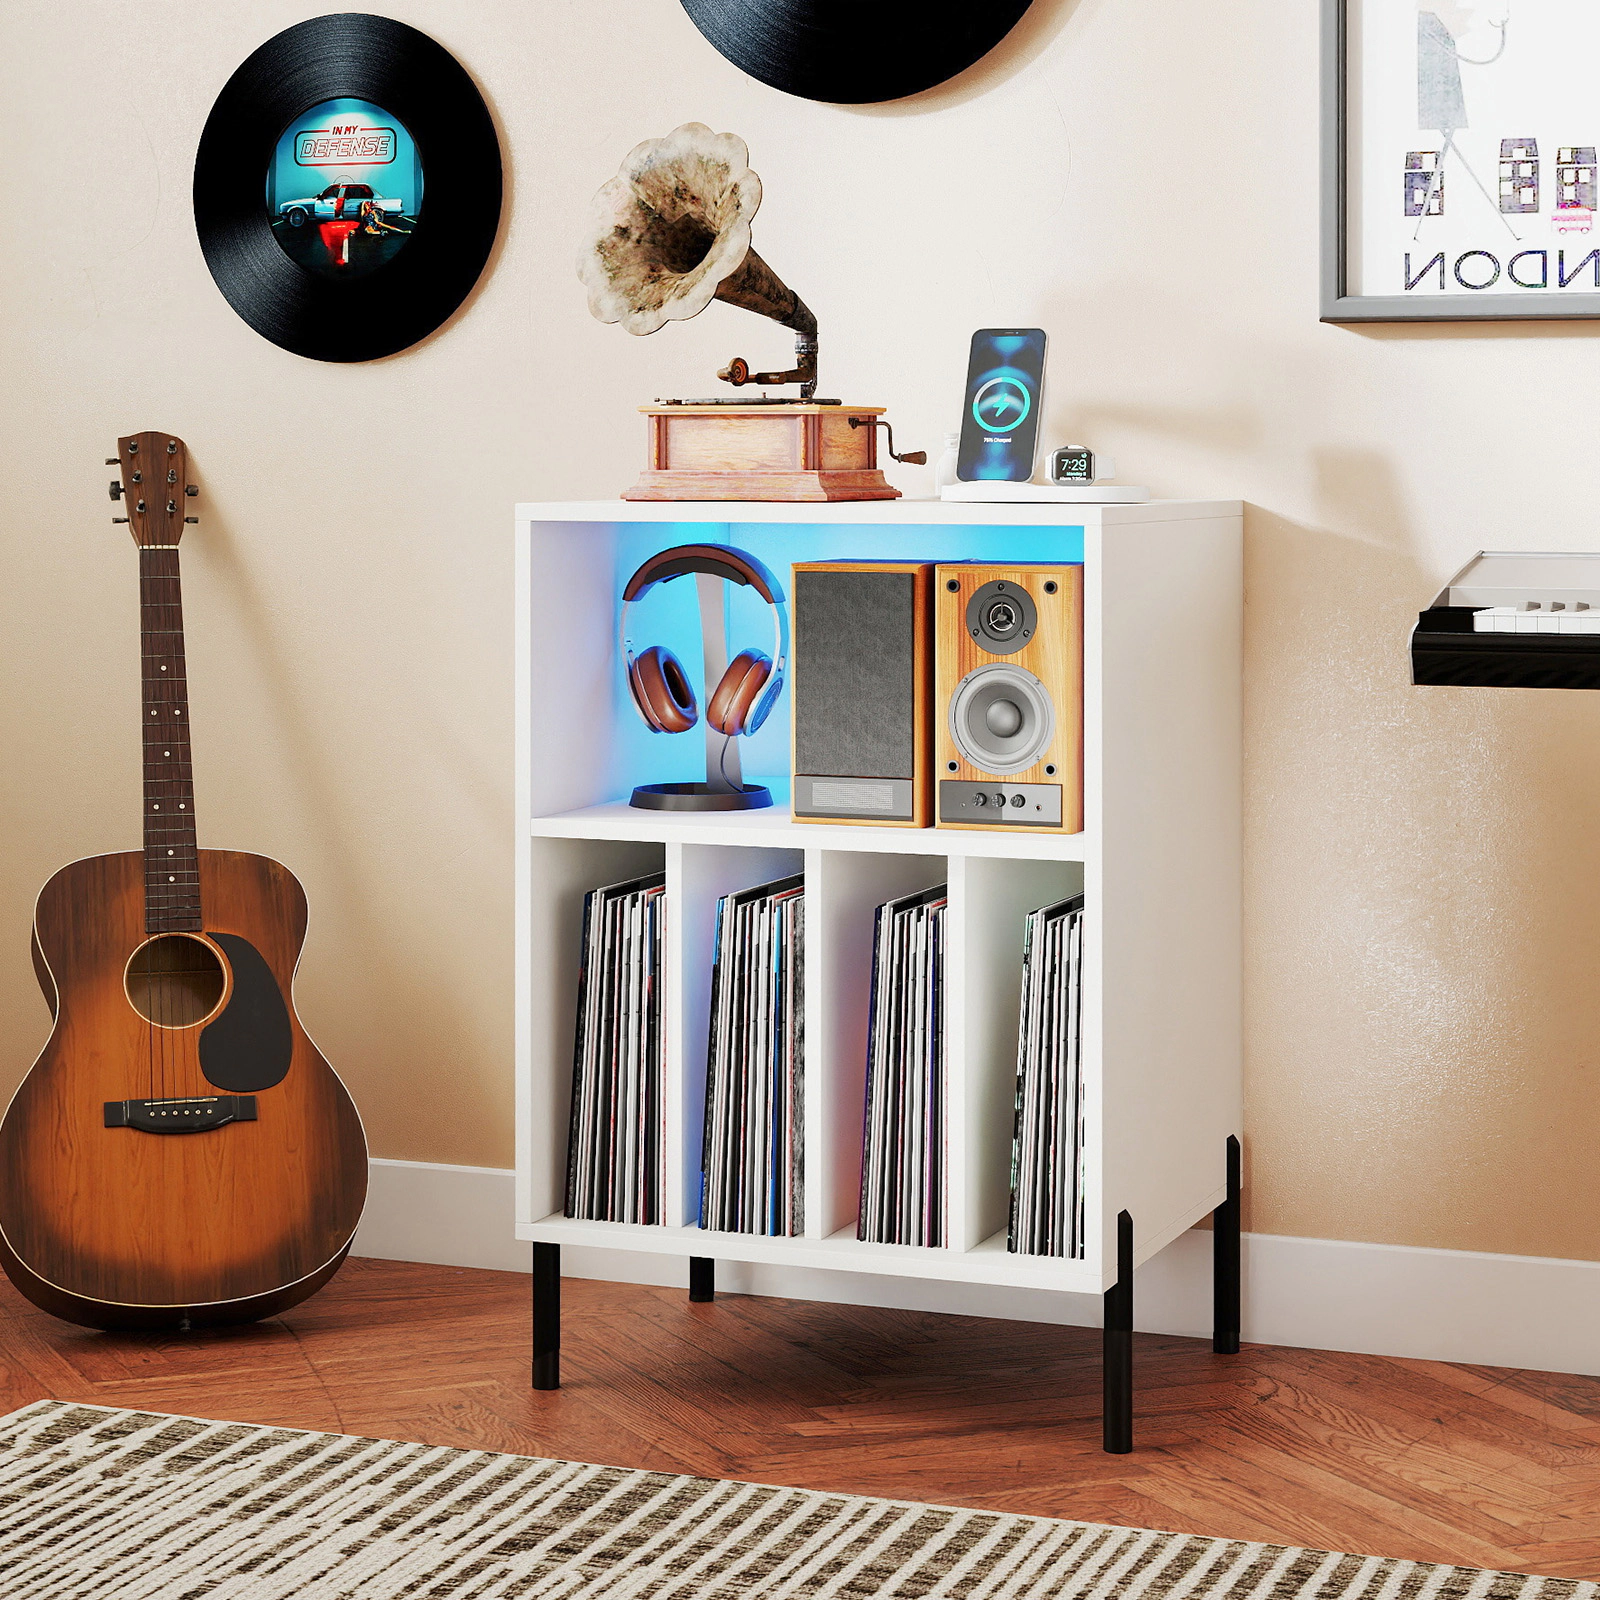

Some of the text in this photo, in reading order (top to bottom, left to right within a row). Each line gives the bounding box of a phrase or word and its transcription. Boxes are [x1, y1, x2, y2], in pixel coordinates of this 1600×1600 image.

[332, 125, 358, 135] IN MY
[300, 136, 391, 158] DEFENSE
[1061, 459, 1087, 471] 7:29
